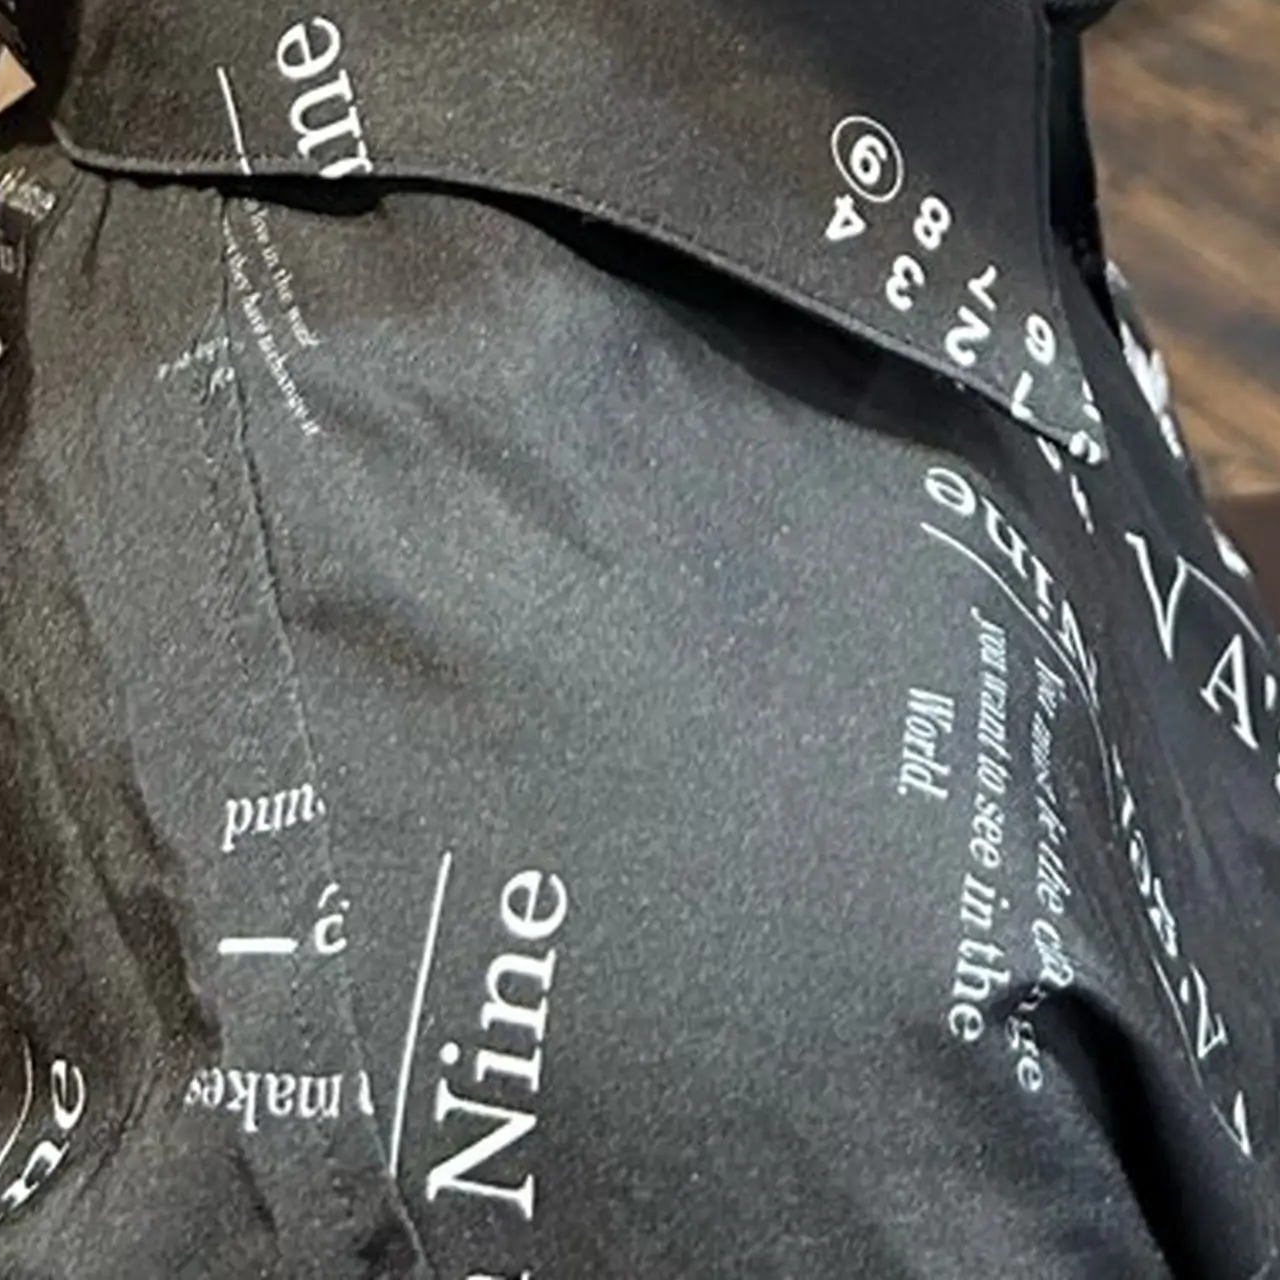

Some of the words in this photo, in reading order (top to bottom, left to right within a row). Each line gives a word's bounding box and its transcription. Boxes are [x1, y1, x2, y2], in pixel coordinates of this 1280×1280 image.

[824, 194, 867, 241] 4
[912, 196, 951, 251] 8
[885, 254, 925, 312] 3
[945, 306, 991, 368] 2
[970, 606, 1009, 674] you
[897, 687, 955, 800] World.
[976, 671, 1012, 761] want
[976, 752, 1012, 795] to
[969, 792, 1006, 870] see
[960, 871, 1011, 932] in
[947, 938, 1011, 1042] the
[426, 869, 569, 1222] Nine
